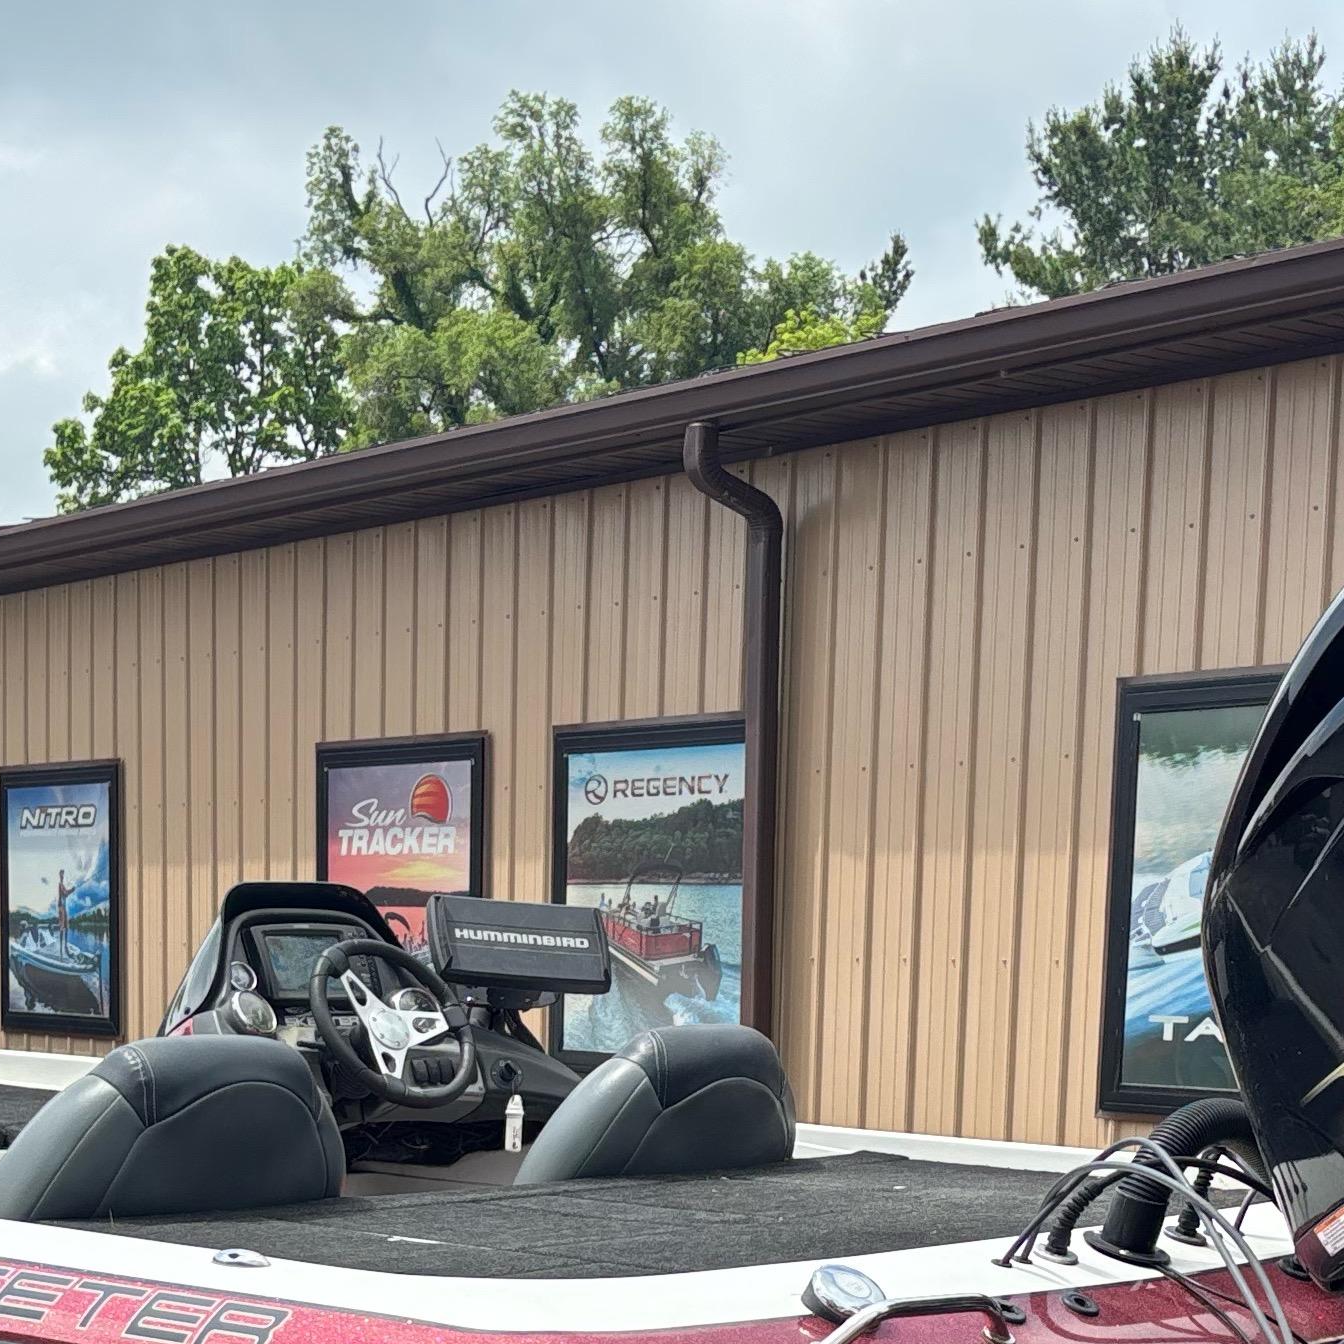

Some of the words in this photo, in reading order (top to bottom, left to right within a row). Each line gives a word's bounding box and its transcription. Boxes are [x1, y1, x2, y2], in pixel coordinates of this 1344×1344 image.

[612, 774, 729, 799] REGENCY
[20, 804, 96, 830] NITRO
[345, 798, 407, 828] Sun
[338, 826, 456, 856] TRACKER
[454, 928, 590, 949] HUMMINBIRD
[1148, 1015, 1226, 1043] TA
